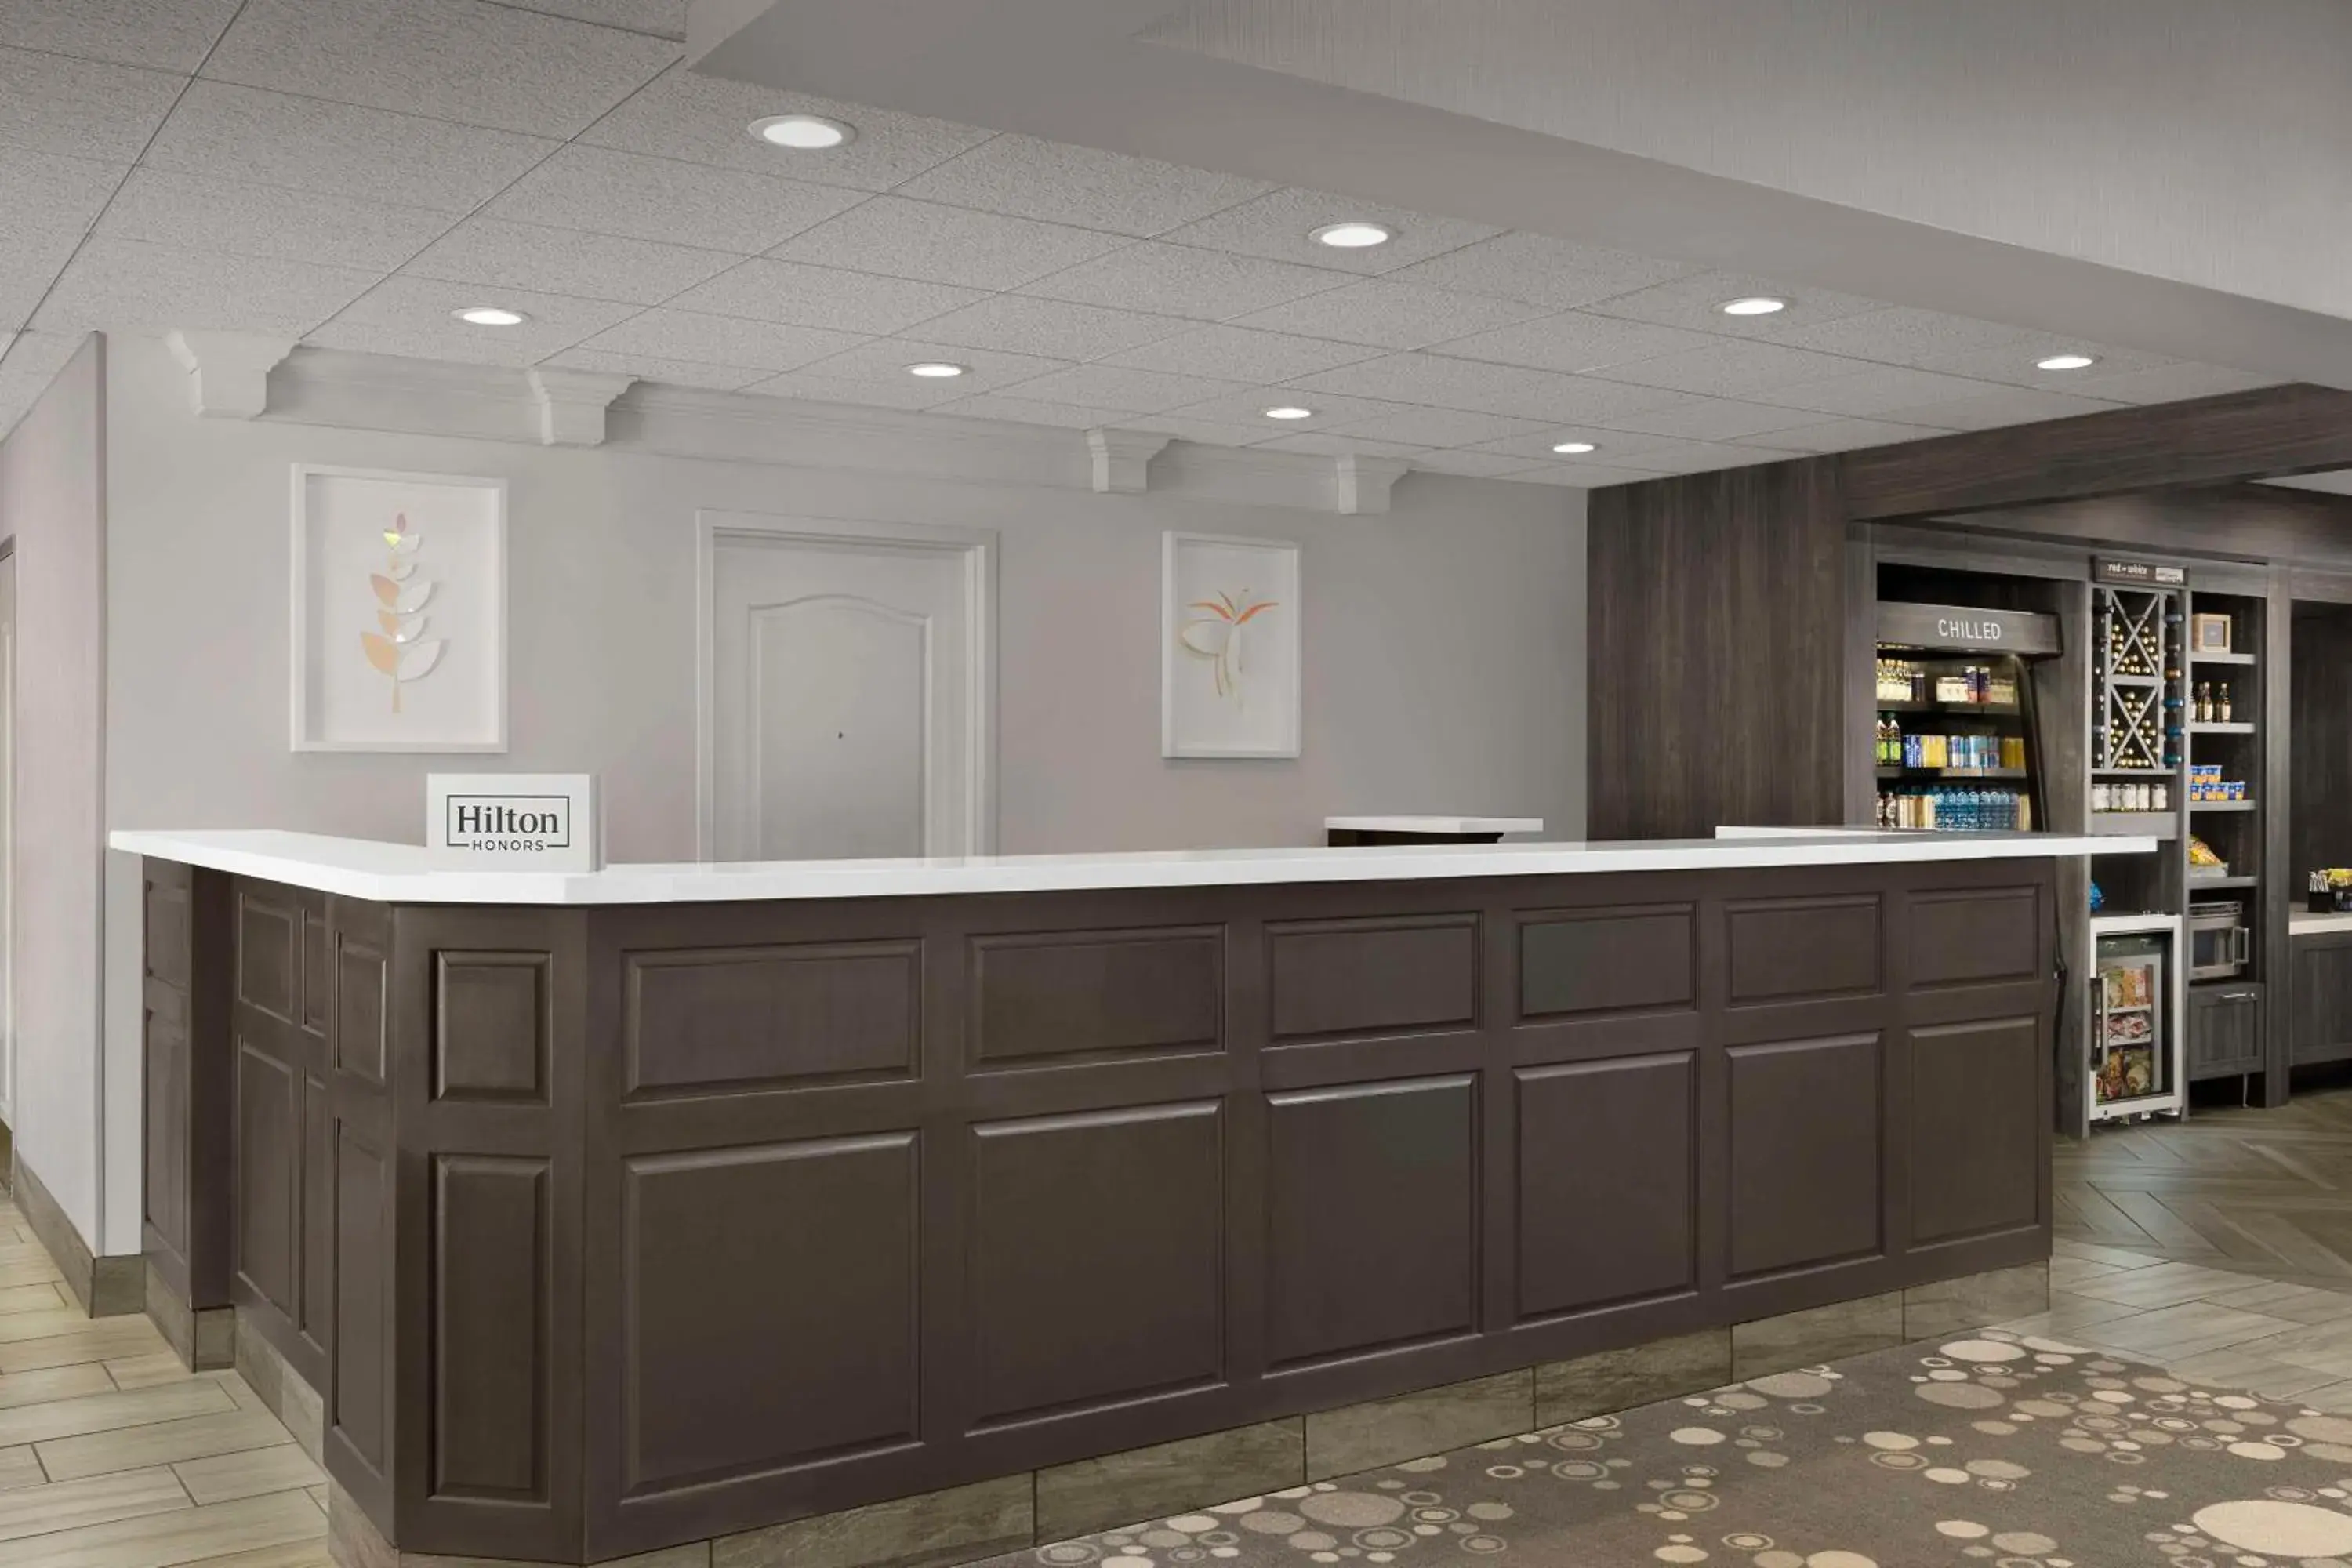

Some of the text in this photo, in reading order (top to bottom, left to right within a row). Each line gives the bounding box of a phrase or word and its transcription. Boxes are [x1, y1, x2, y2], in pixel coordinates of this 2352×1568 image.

[1938, 619, 2002, 640] CHILLED
[458, 806, 559, 833] Hilton
[472, 840, 544, 851] HONORS
